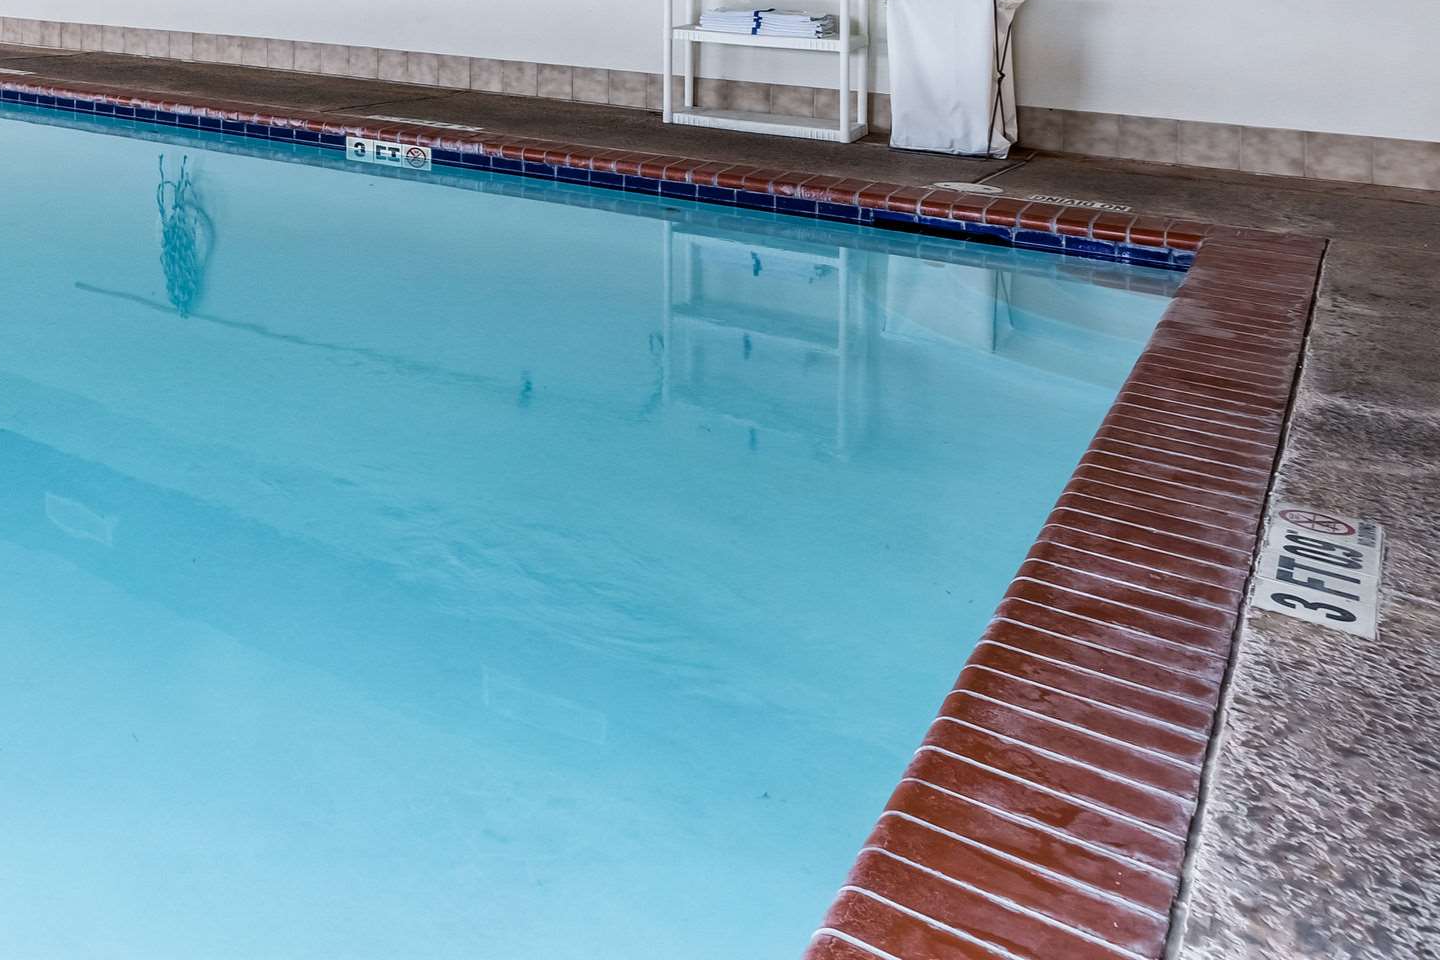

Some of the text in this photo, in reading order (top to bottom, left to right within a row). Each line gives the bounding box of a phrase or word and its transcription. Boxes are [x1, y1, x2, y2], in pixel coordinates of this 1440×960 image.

[353, 141, 366, 157] 3
[1033, 195, 1127, 211] NO DIVING
[1275, 555, 1361, 602] FT
[1270, 592, 1357, 622] 3
